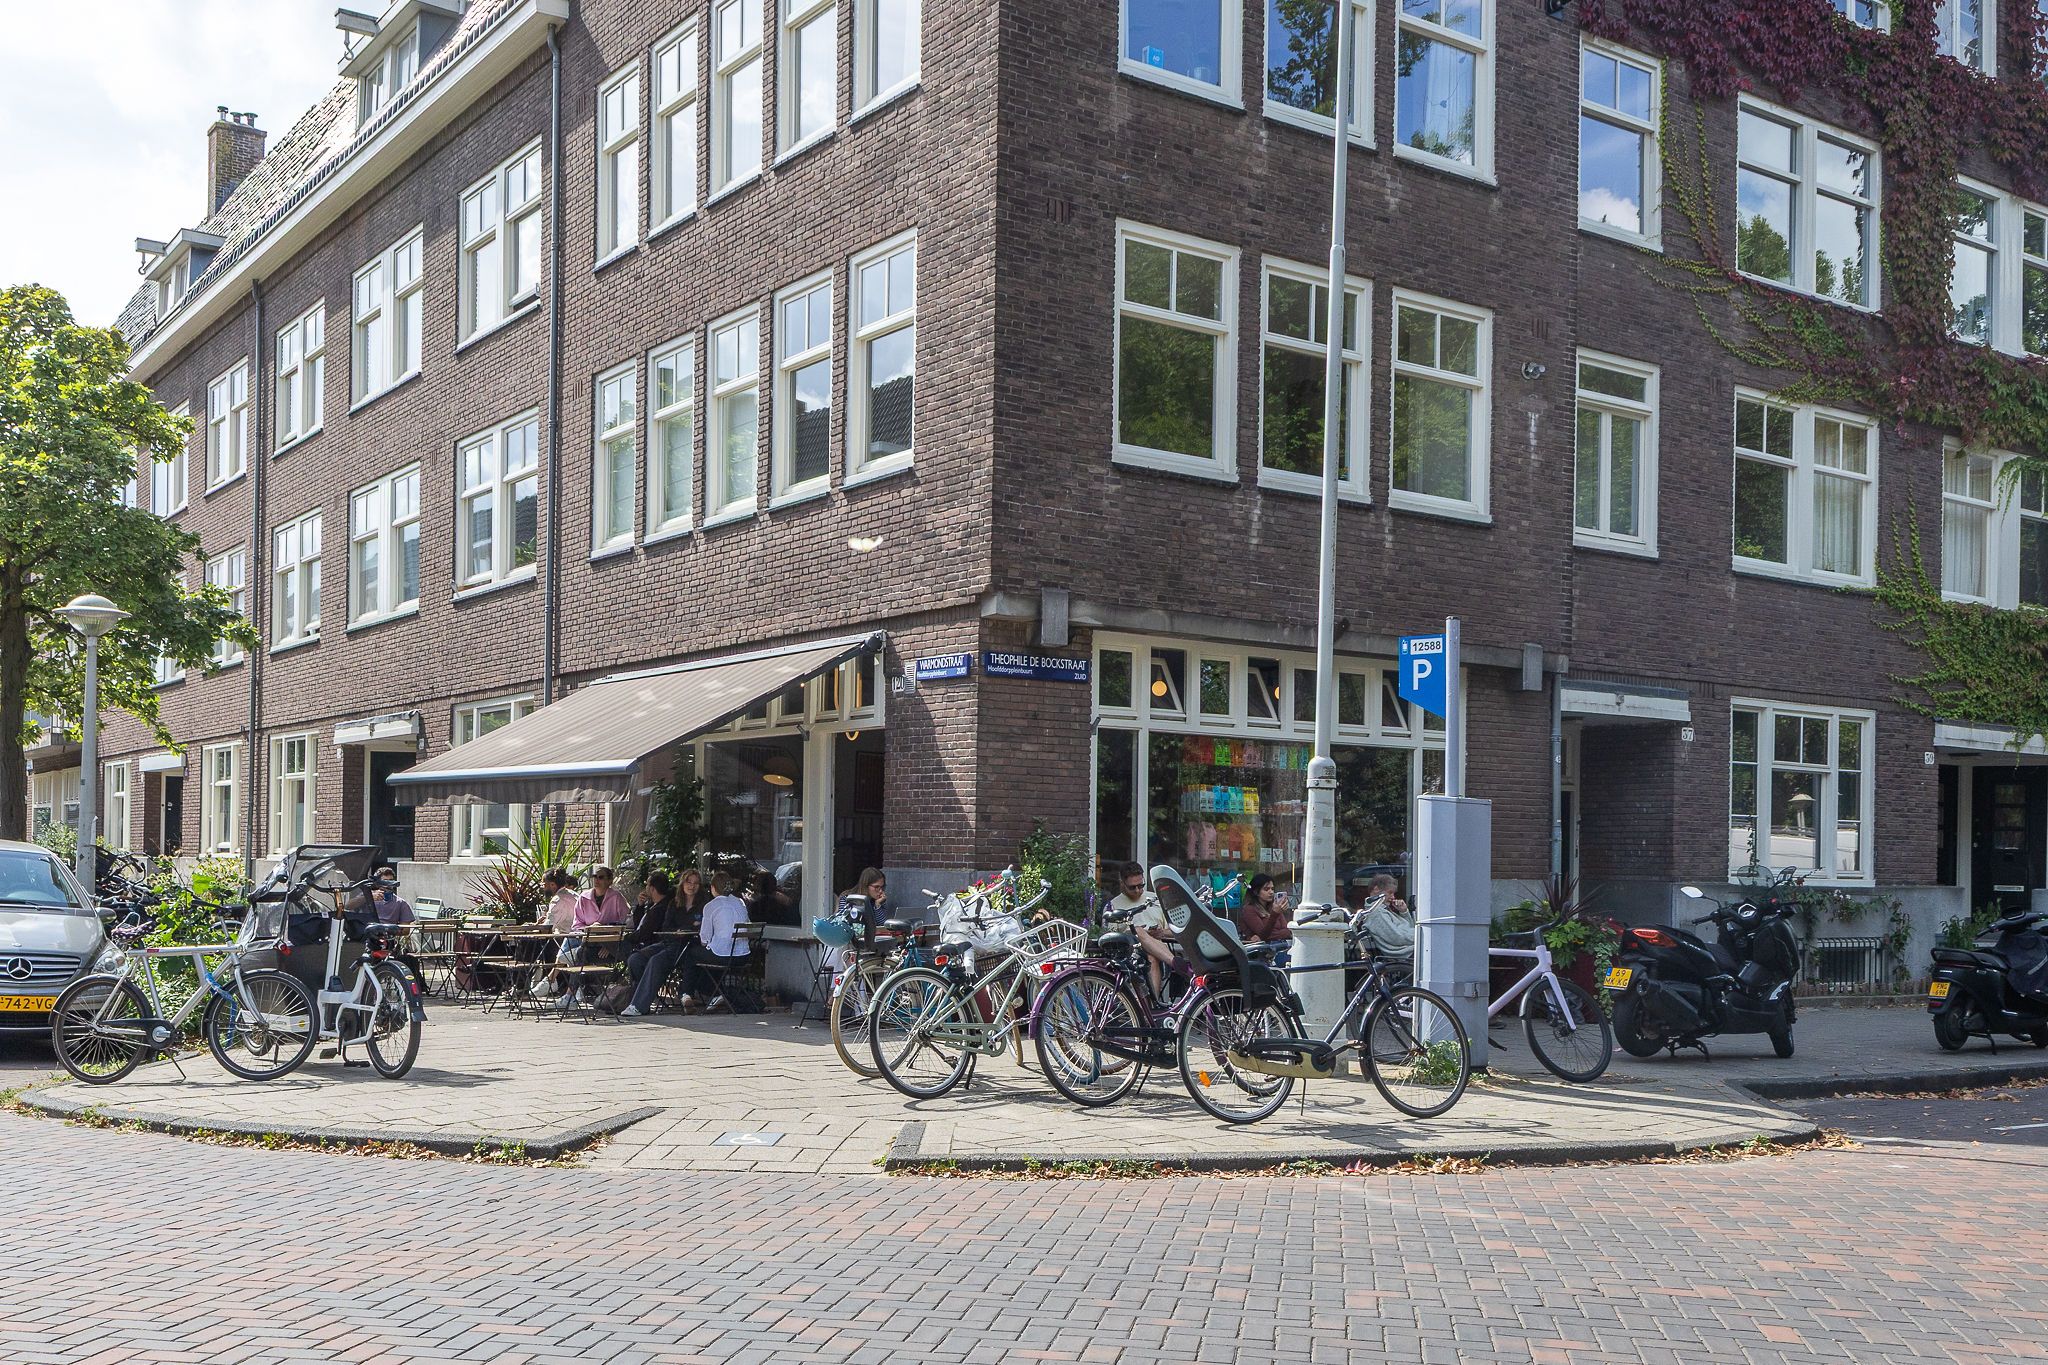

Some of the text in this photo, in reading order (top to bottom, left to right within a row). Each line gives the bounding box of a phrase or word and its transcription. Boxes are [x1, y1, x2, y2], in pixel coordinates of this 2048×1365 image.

[1412, 641, 1441, 651] 12588
[920, 655, 964, 670] WARMONDSTRAAT
[990, 653, 1087, 671] THEOPHILE DE BOCKSTRAAT
[1413, 659, 1432, 690] P
[1616, 969, 1627, 977] 69
